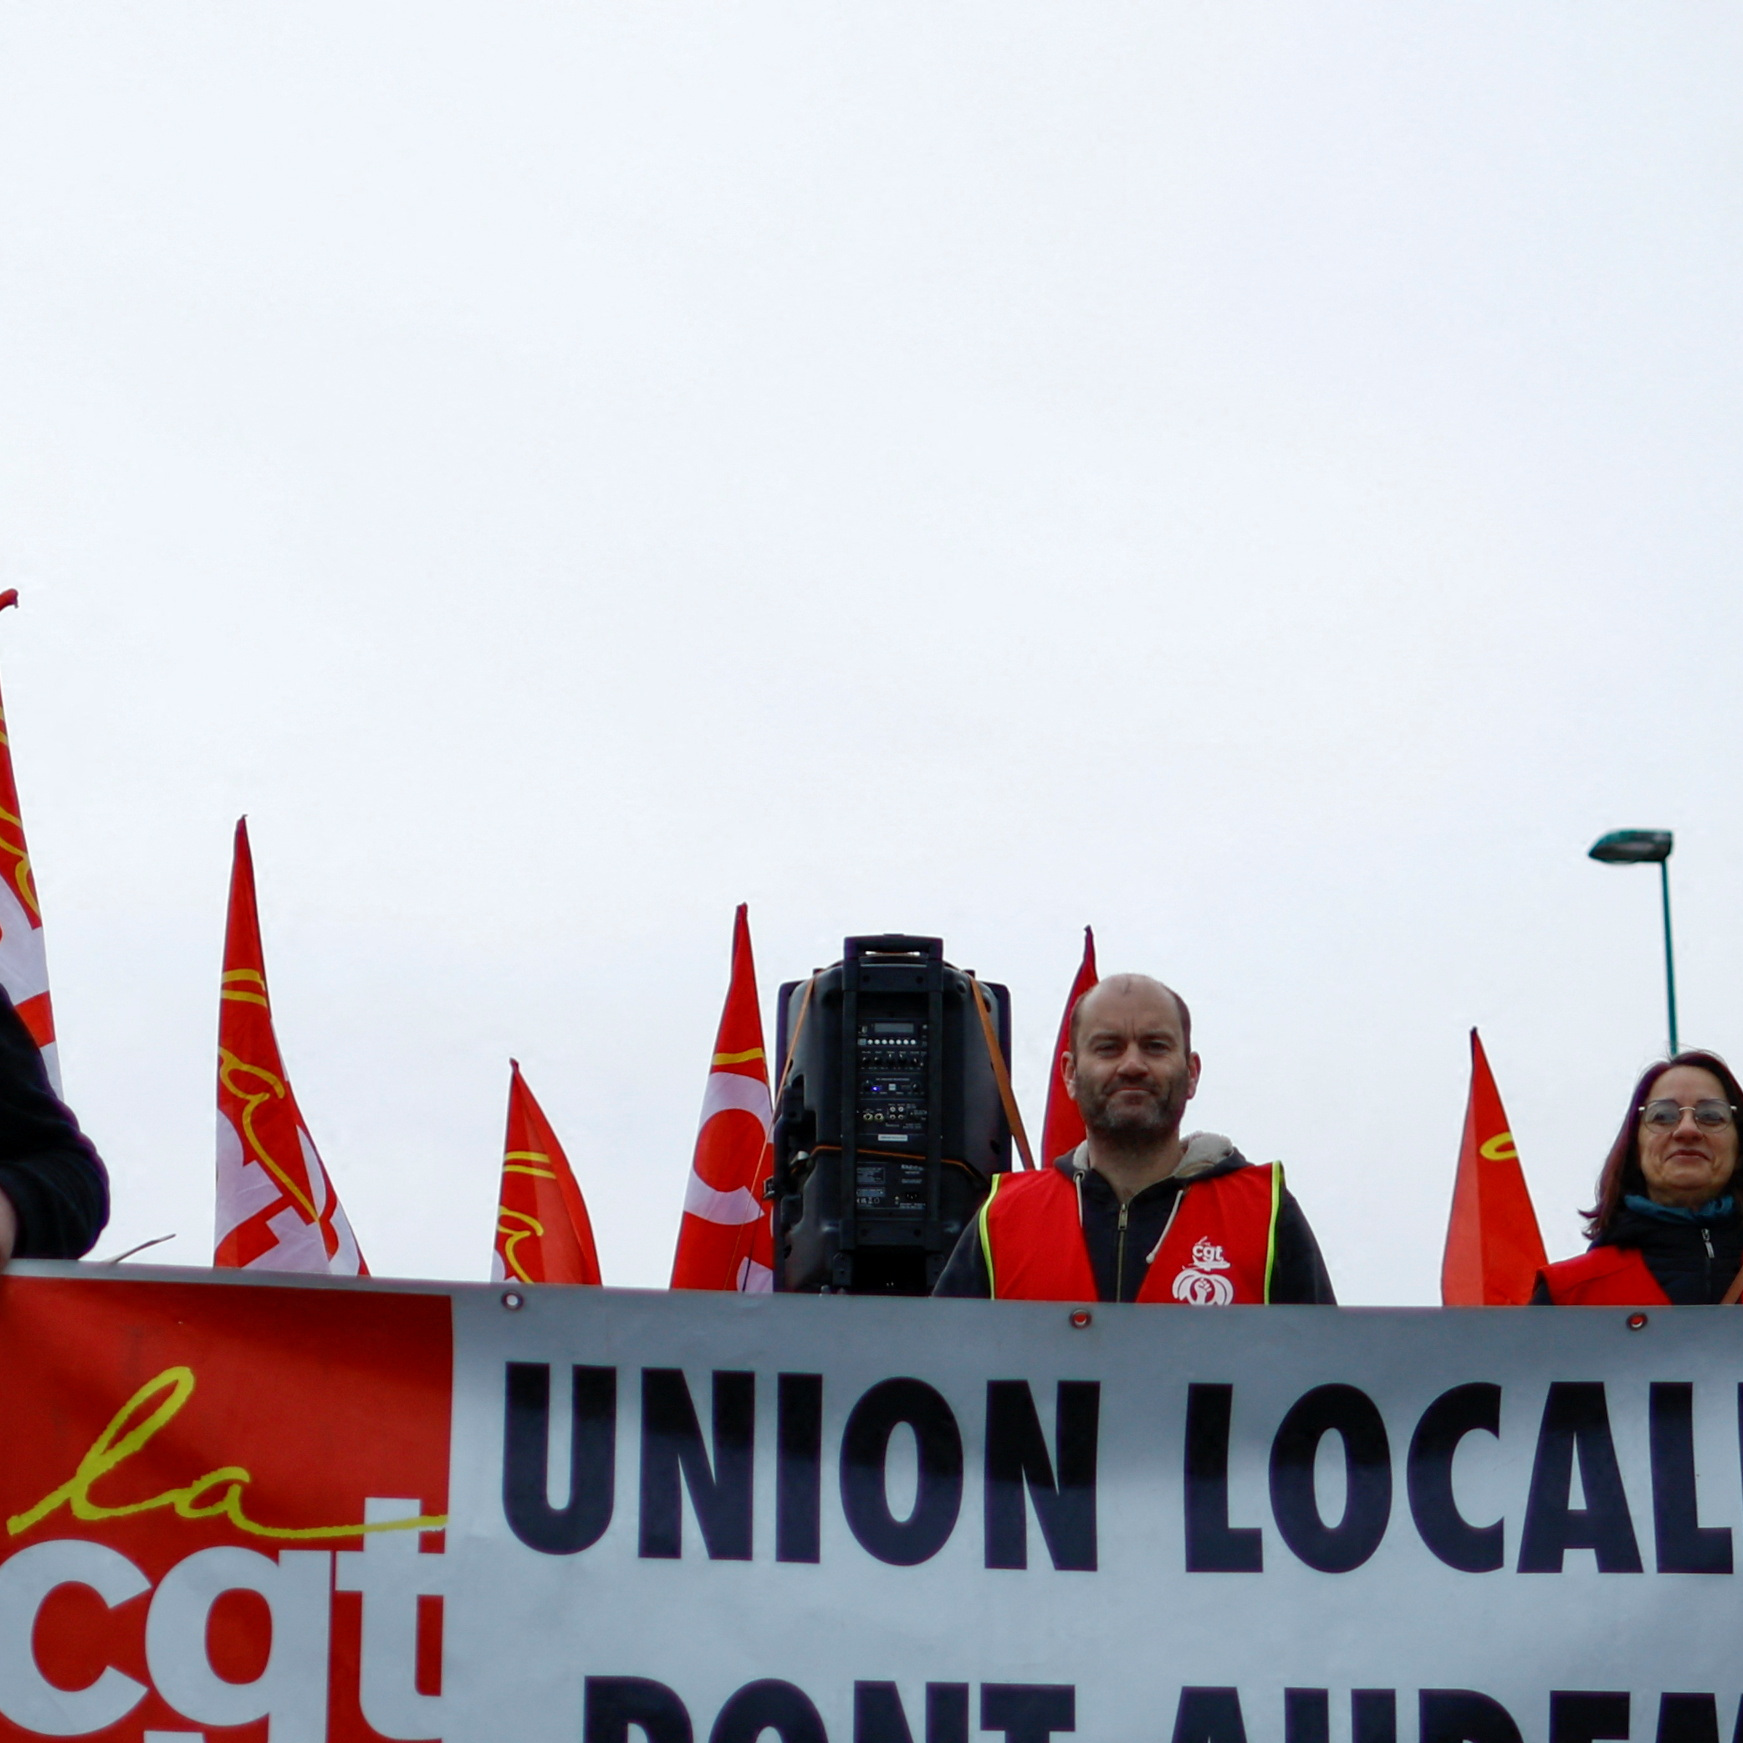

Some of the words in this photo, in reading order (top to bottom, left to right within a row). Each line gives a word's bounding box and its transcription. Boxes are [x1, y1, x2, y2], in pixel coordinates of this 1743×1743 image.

[1192, 1244, 1225, 1263] cgt
[7, 1366, 448, 1539] la
[501, 1361, 1101, 1572] UNION
